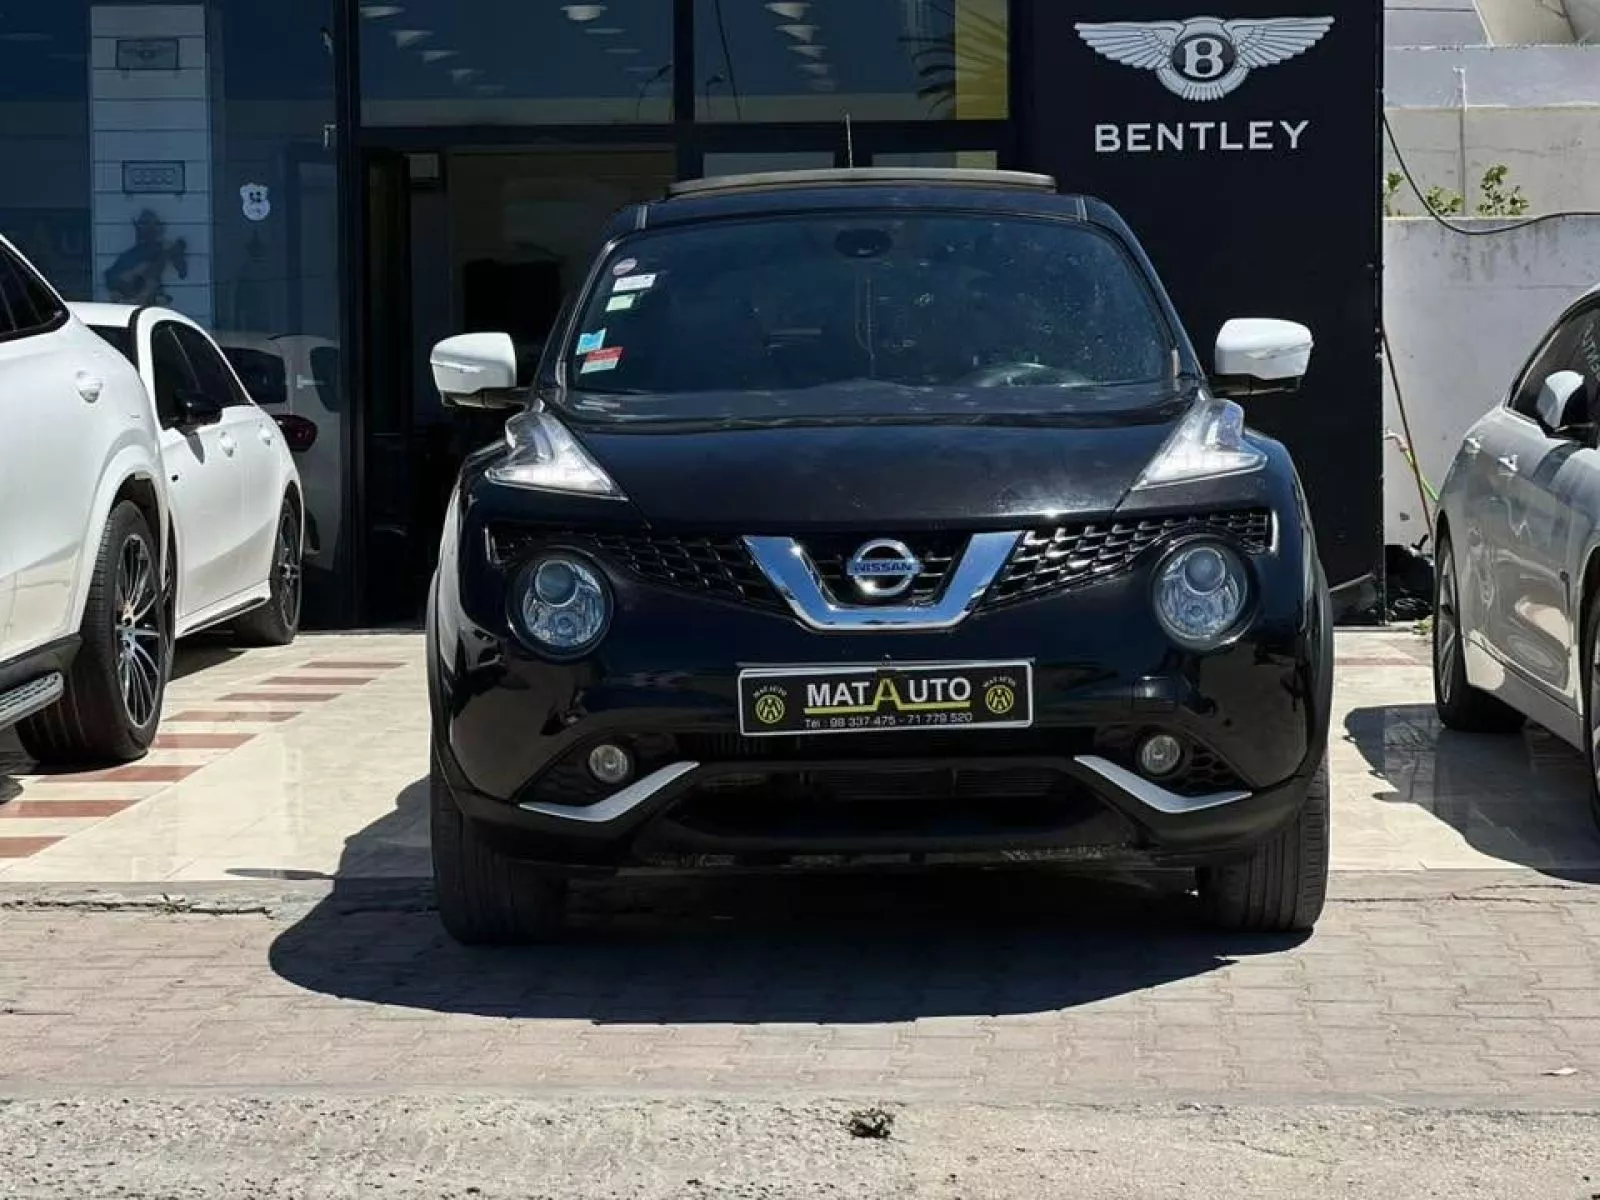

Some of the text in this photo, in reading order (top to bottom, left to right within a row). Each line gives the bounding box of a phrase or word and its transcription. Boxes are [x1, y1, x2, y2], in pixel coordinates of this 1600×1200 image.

[1183, 37, 1224, 79] B
[1095, 120, 1310, 152] BENTLEY
[853, 562, 913, 573] NISSAN
[806, 677, 972, 711] MAT AUTO
[829, 717, 846, 729] 98
[850, 716, 870, 728] 337
[873, 715, 896, 726] 475
[907, 714, 921, 725] 71
[925, 713, 947, 724] 779
[951, 712, 973, 723] 520
